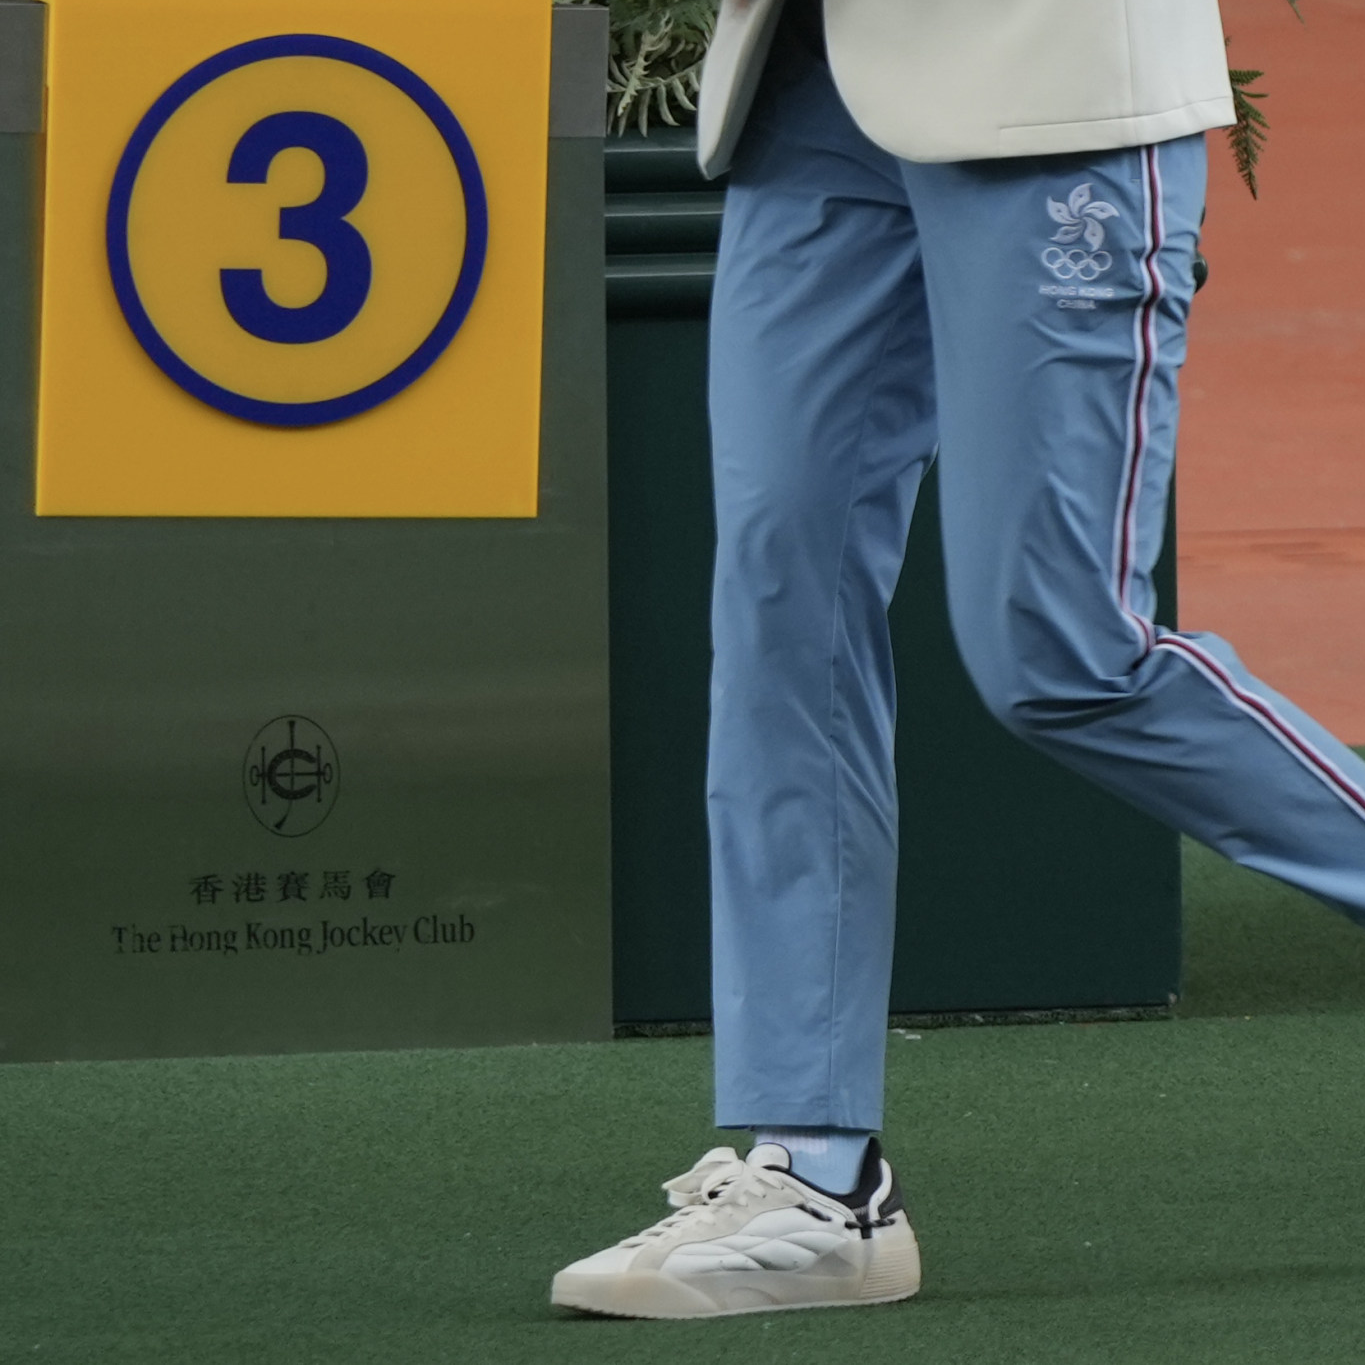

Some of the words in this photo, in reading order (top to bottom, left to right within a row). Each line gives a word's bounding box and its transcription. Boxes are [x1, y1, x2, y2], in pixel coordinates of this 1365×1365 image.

[219, 111, 373, 345] 3
[189, 867, 396, 905] 香港賽馬會
[112, 923, 162, 954] The
[168, 923, 238, 955] Hong
[246, 922, 313, 955] Kong
[317, 915, 407, 954] Jockey
[413, 914, 475, 945] Club
